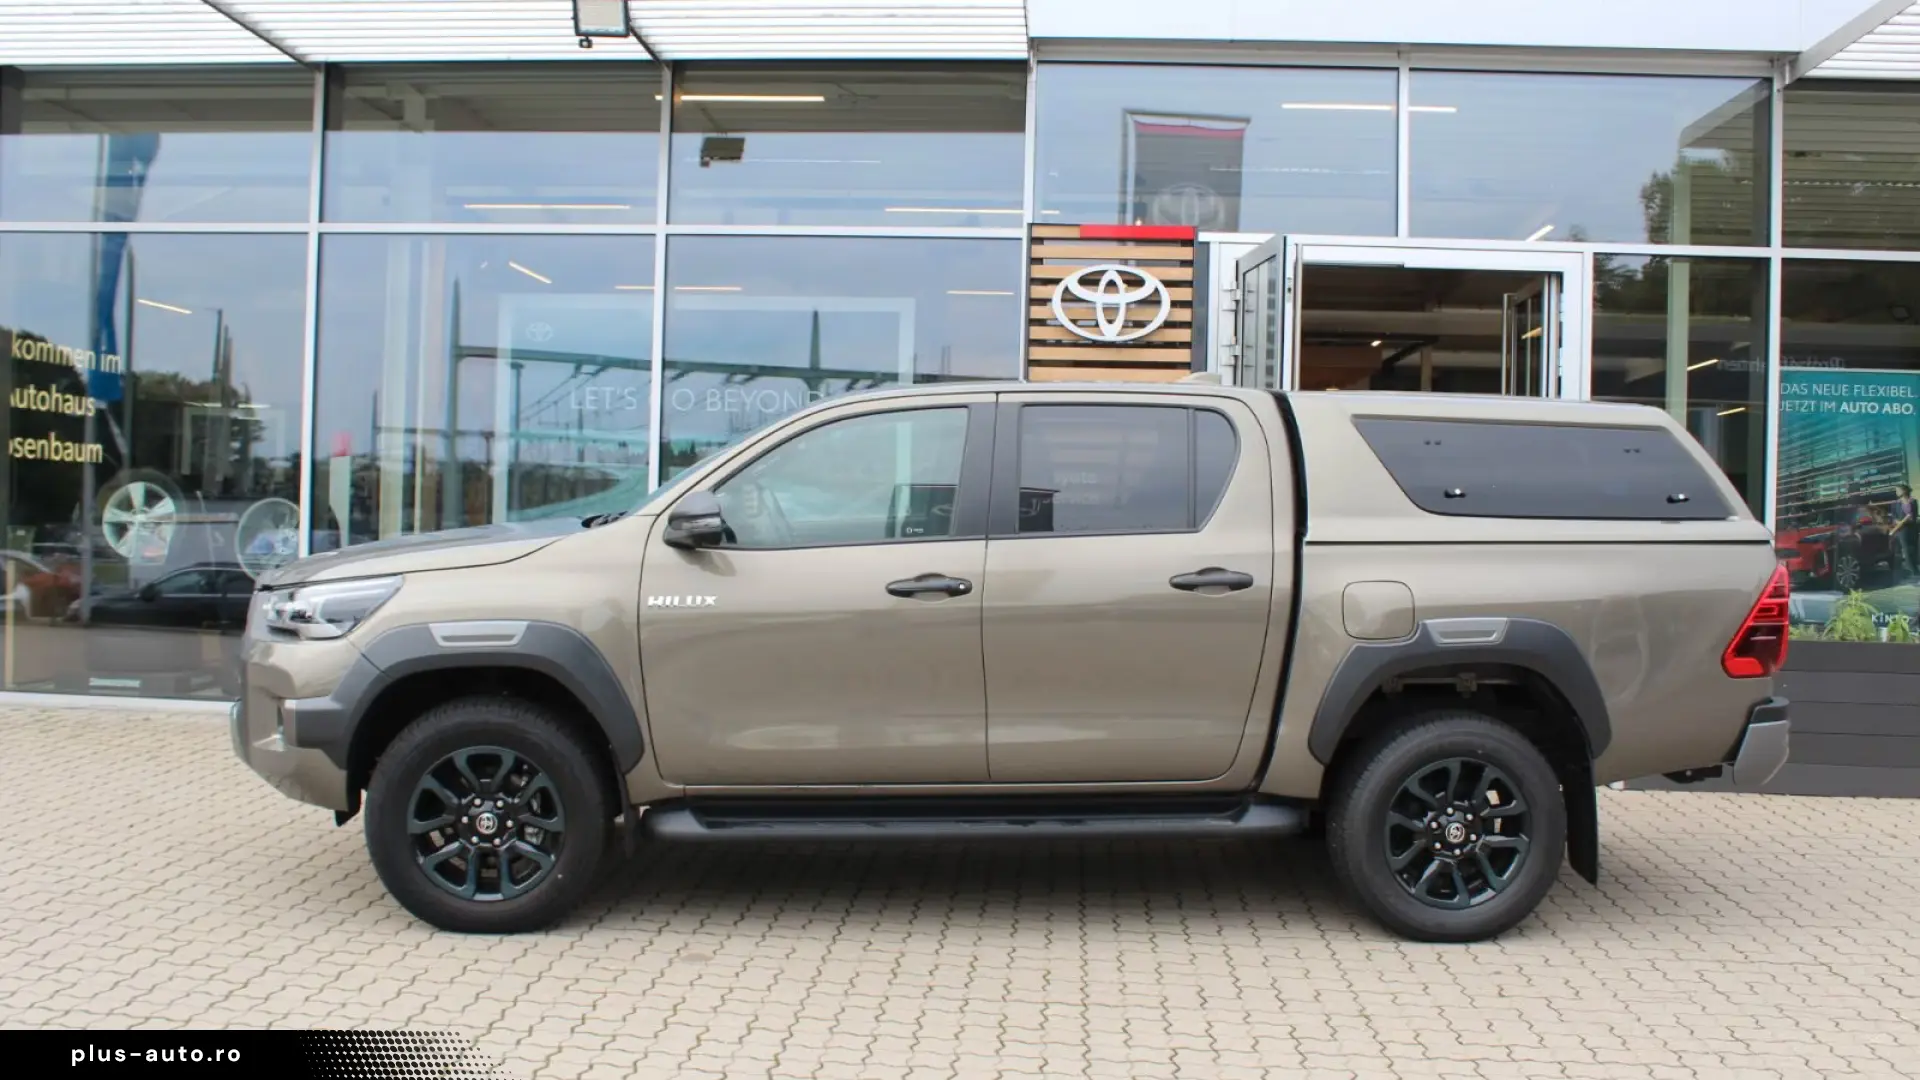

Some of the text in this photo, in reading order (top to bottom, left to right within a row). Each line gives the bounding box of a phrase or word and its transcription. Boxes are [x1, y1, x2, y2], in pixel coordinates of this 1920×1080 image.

[101, 345, 121, 373] im
[1780, 383, 1809, 396] DAS
[1812, 383, 1849, 397] NEUE
[570, 387, 637, 411] LET'S
[1779, 400, 1916, 415] JETZT IM AUTO ABO.
[647, 595, 719, 607] HILUX
